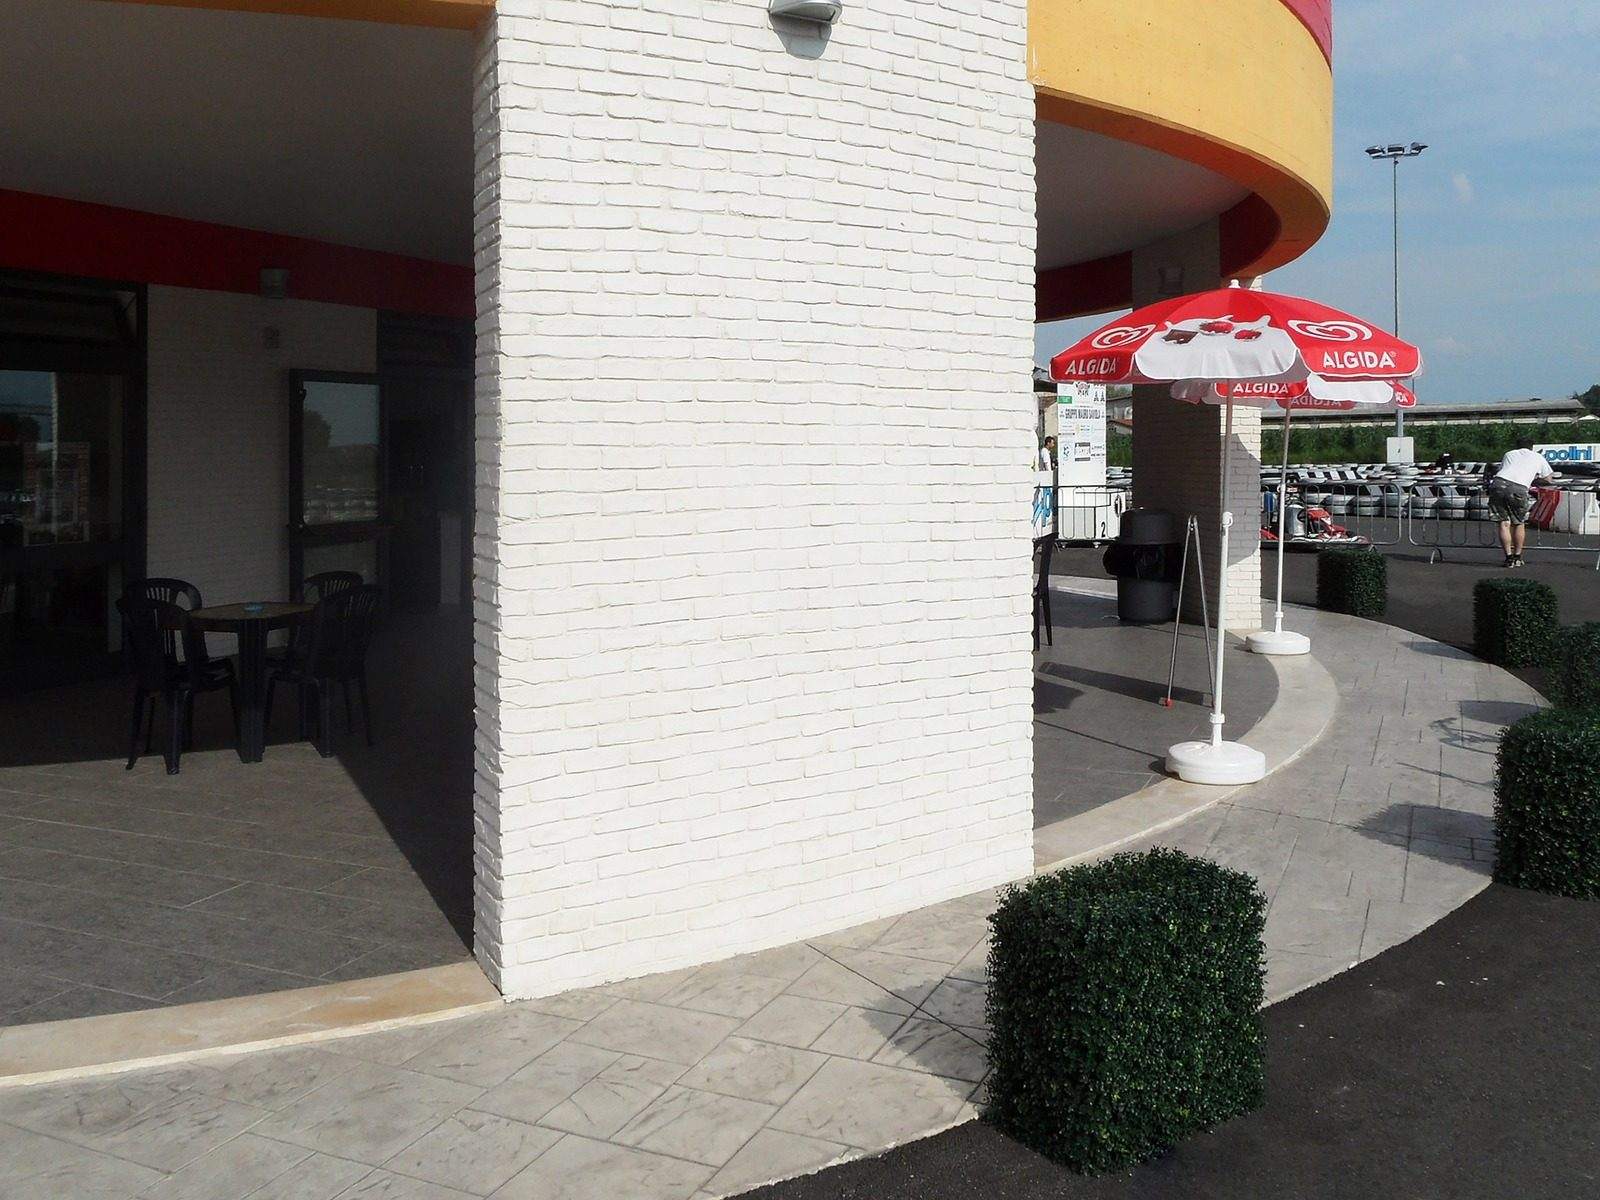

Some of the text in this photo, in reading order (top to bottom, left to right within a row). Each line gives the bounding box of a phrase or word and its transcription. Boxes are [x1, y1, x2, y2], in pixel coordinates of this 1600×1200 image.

[1065, 358, 1117, 375] ALGIDA
[1323, 351, 1396, 369] ALGIDA
[1232, 383, 1289, 394] ALGIDA
[1544, 446, 1593, 461] polini
[1101, 521, 1106, 538] 2
